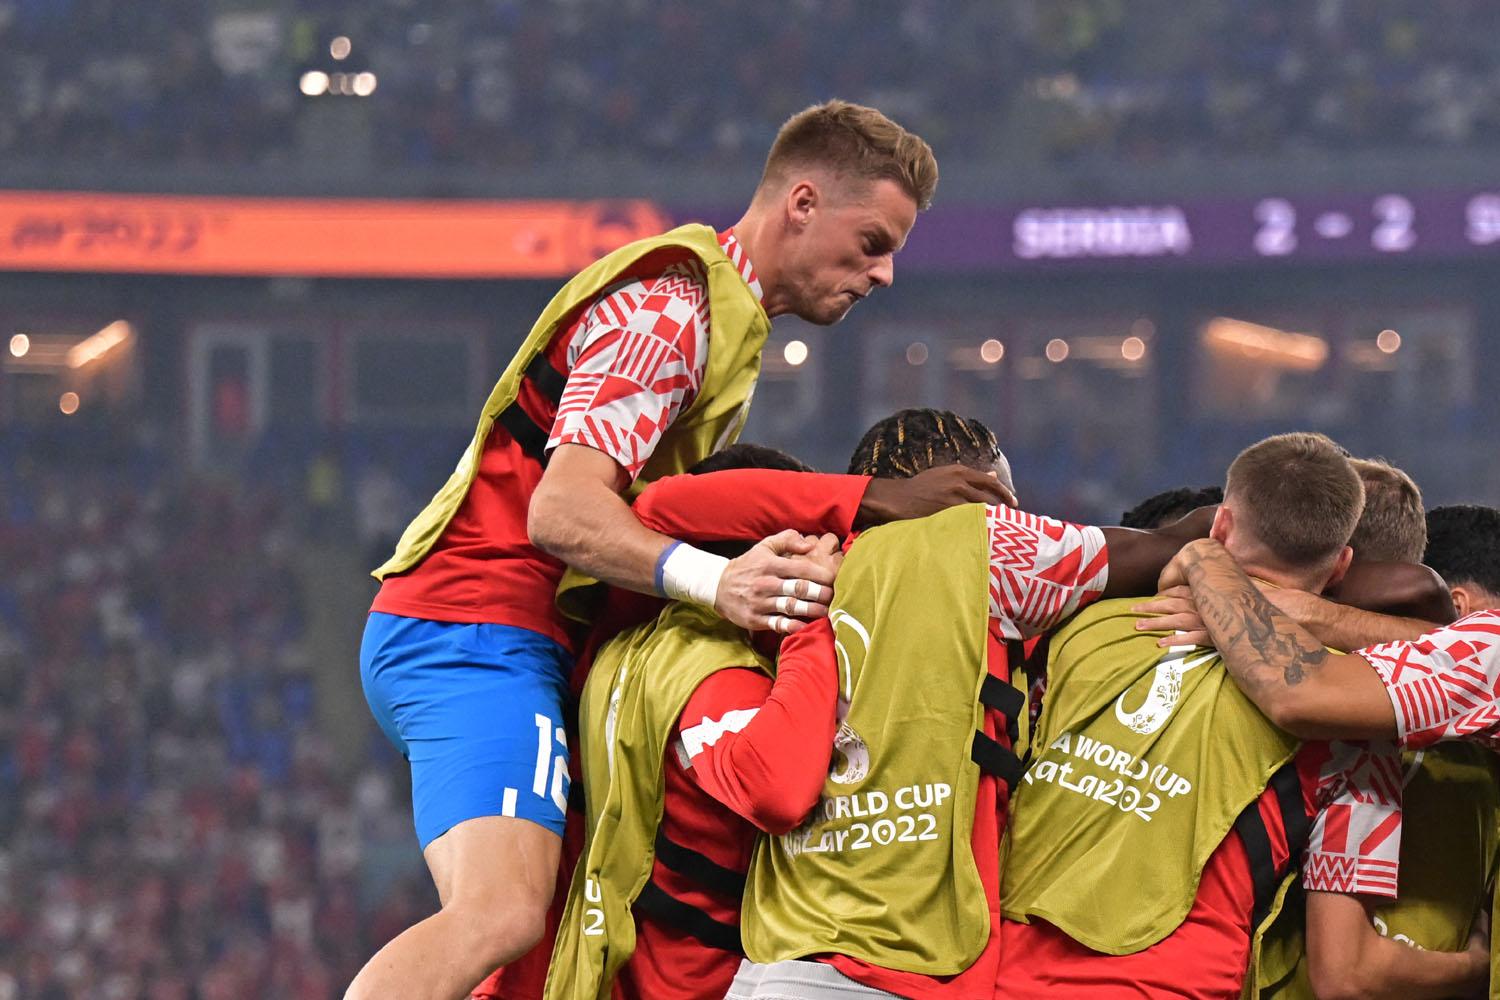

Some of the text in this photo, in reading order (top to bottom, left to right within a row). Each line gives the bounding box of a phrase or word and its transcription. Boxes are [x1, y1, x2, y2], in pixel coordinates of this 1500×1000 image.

[1013, 206, 1192, 258] SERBIA
[1252, 197, 1297, 256] 2
[1371, 192, 1417, 251] 2
[1075, 735, 1149, 780] WORLD
[814, 783, 951, 825] ORLD CUP
